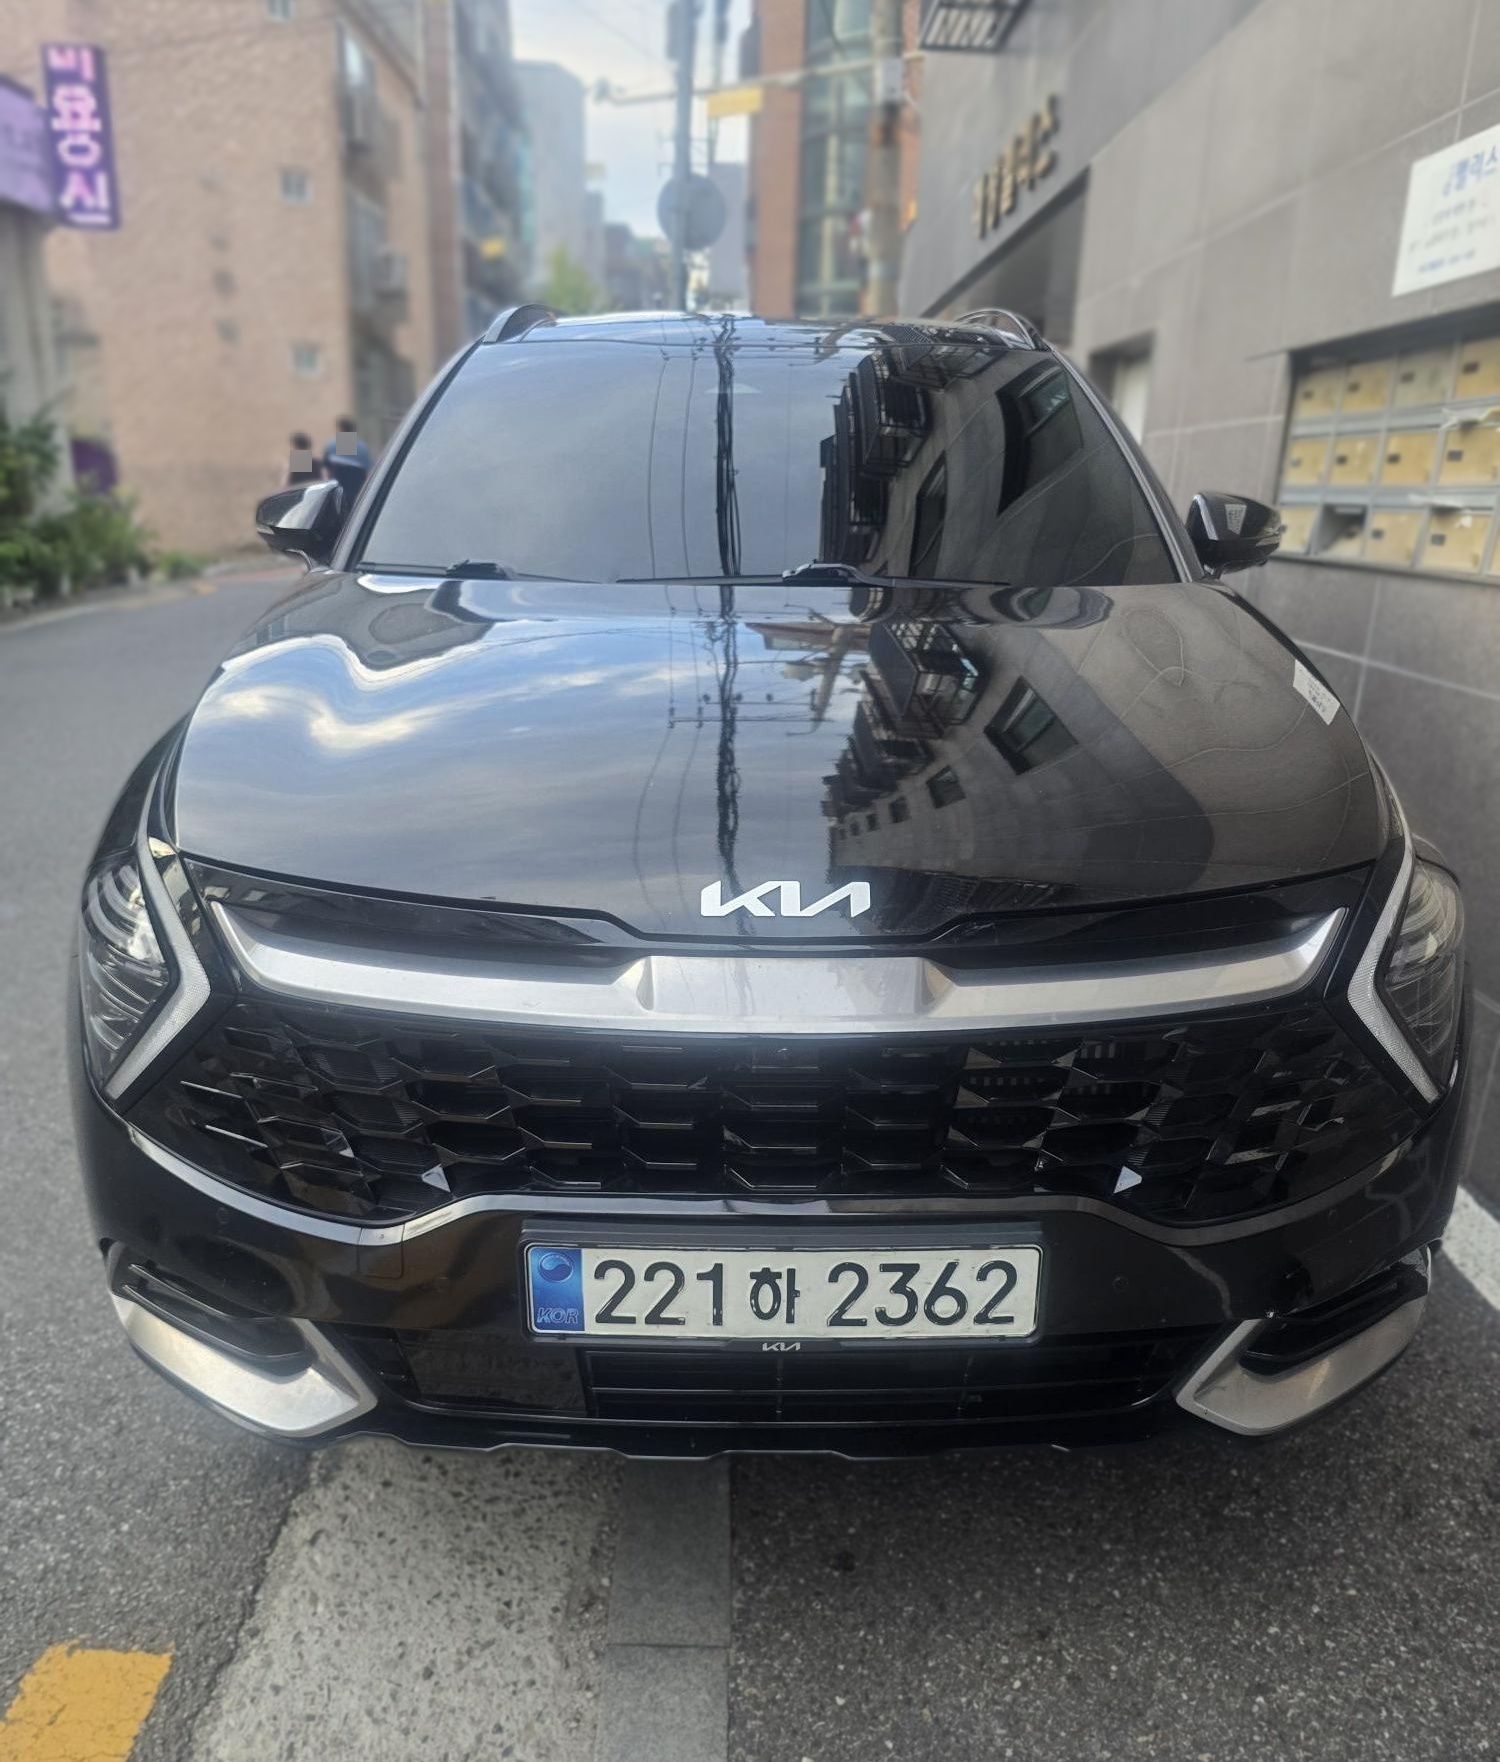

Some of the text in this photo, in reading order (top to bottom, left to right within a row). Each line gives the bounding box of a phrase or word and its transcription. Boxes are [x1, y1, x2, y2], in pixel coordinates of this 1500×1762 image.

[700, 880, 871, 918] KIA
[826, 1260, 1018, 1328] 2362
[536, 1307, 580, 1324] KOR
[762, 1342, 802, 1352] KIA
